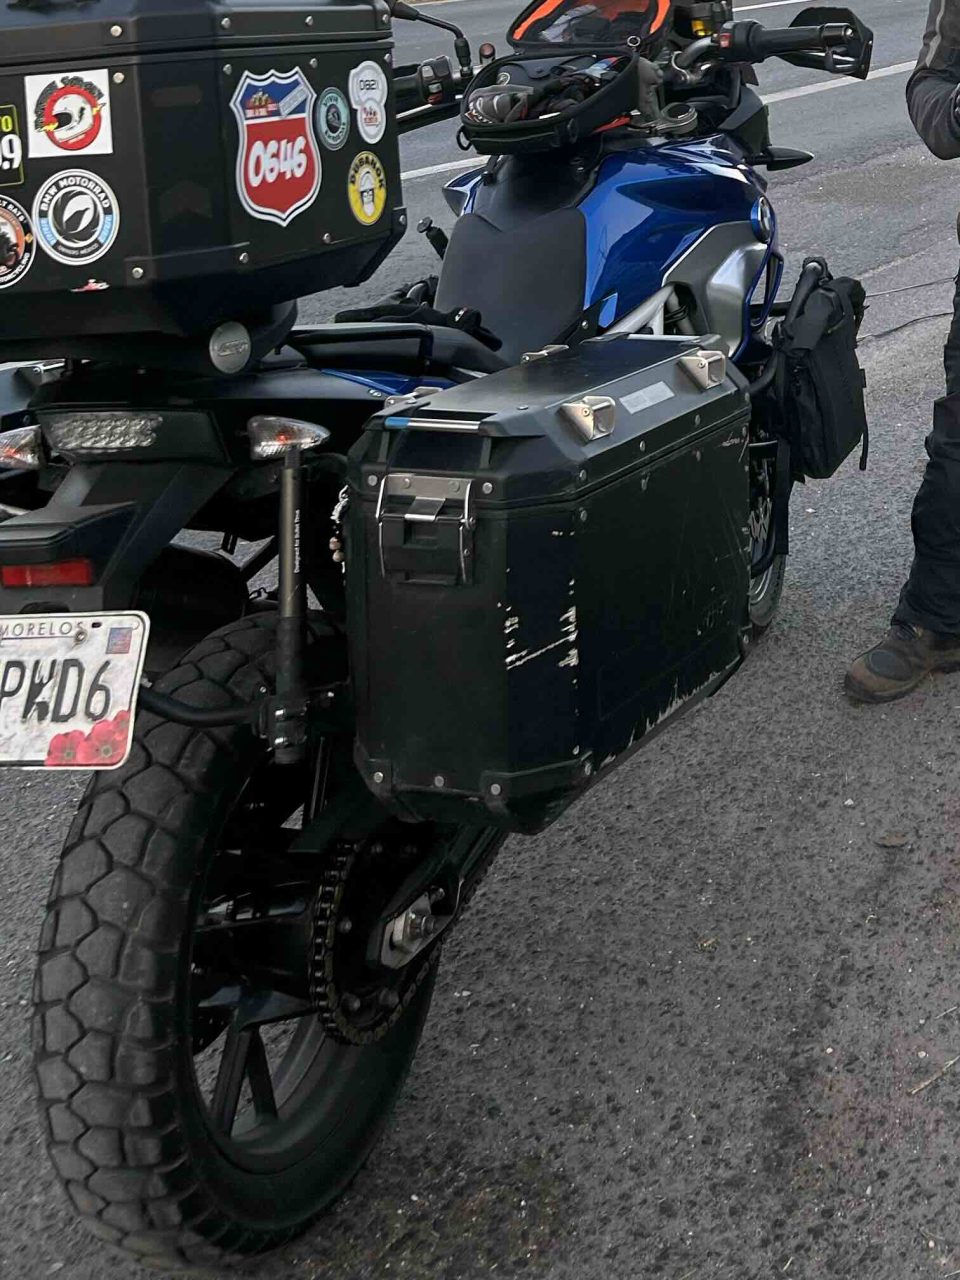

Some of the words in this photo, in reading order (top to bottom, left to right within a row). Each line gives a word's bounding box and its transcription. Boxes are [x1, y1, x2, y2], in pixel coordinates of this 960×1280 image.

[247, 135, 308, 187] 0646
[40, 185, 59, 211] BMW
[58, 176, 111, 208] MOTORRAD
[0, 621, 84, 636] MORELOS
